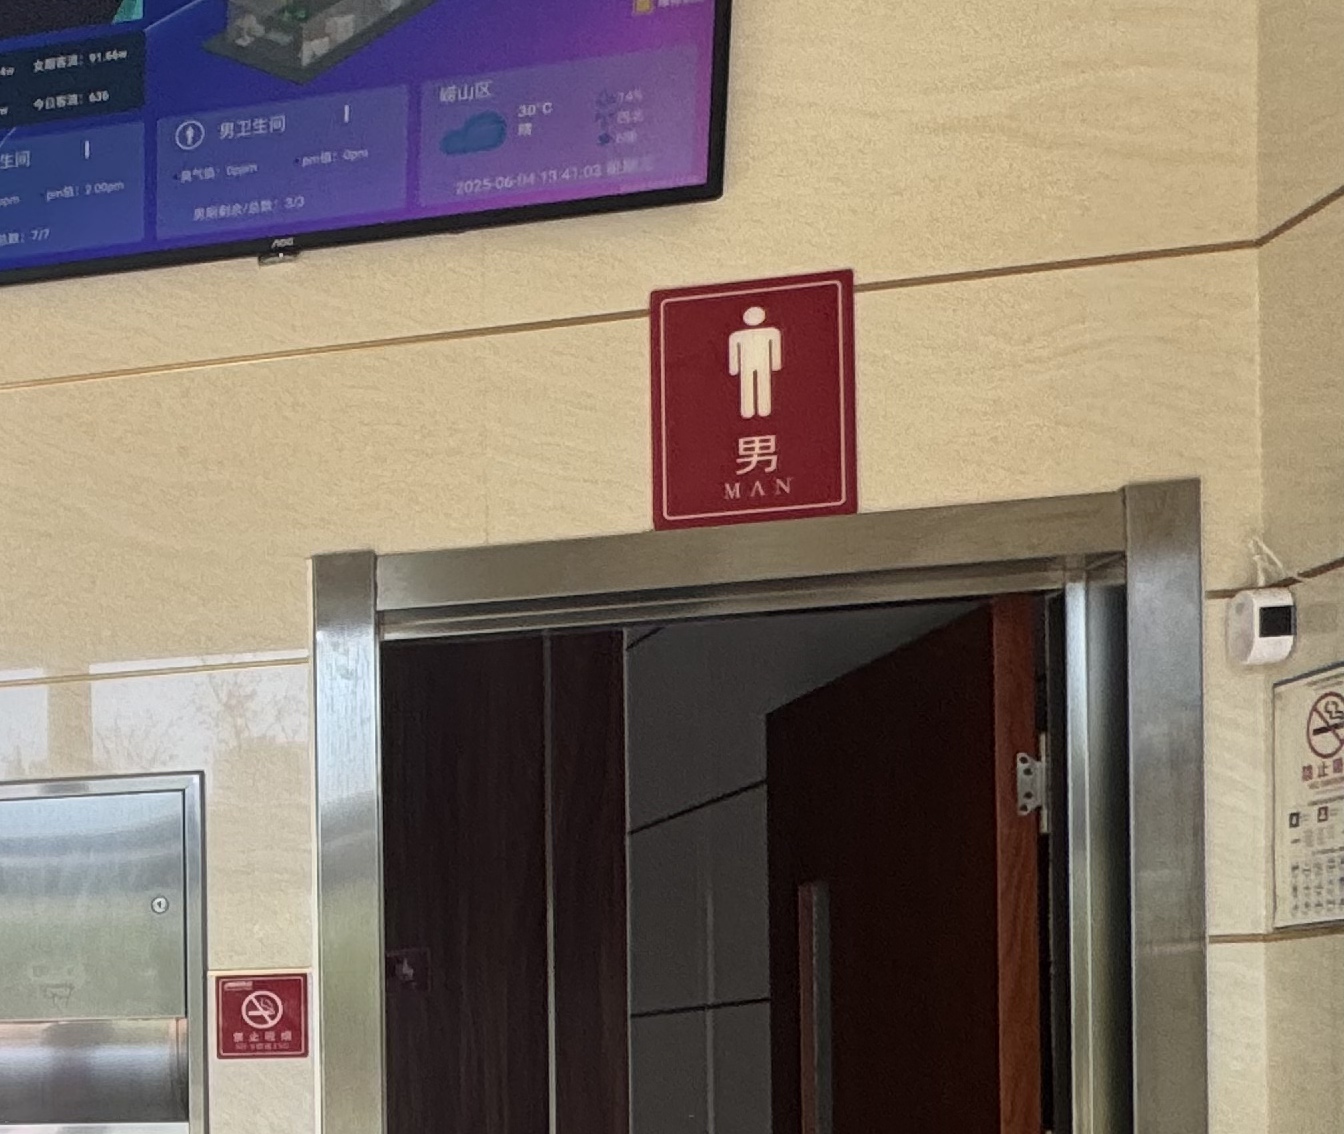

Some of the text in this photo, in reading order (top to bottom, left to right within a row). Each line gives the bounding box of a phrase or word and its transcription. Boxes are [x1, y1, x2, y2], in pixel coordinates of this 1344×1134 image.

[219, 115, 286, 140] 男卫生间
[735, 434, 778, 476] 男
[723, 477, 793, 500] MAN
